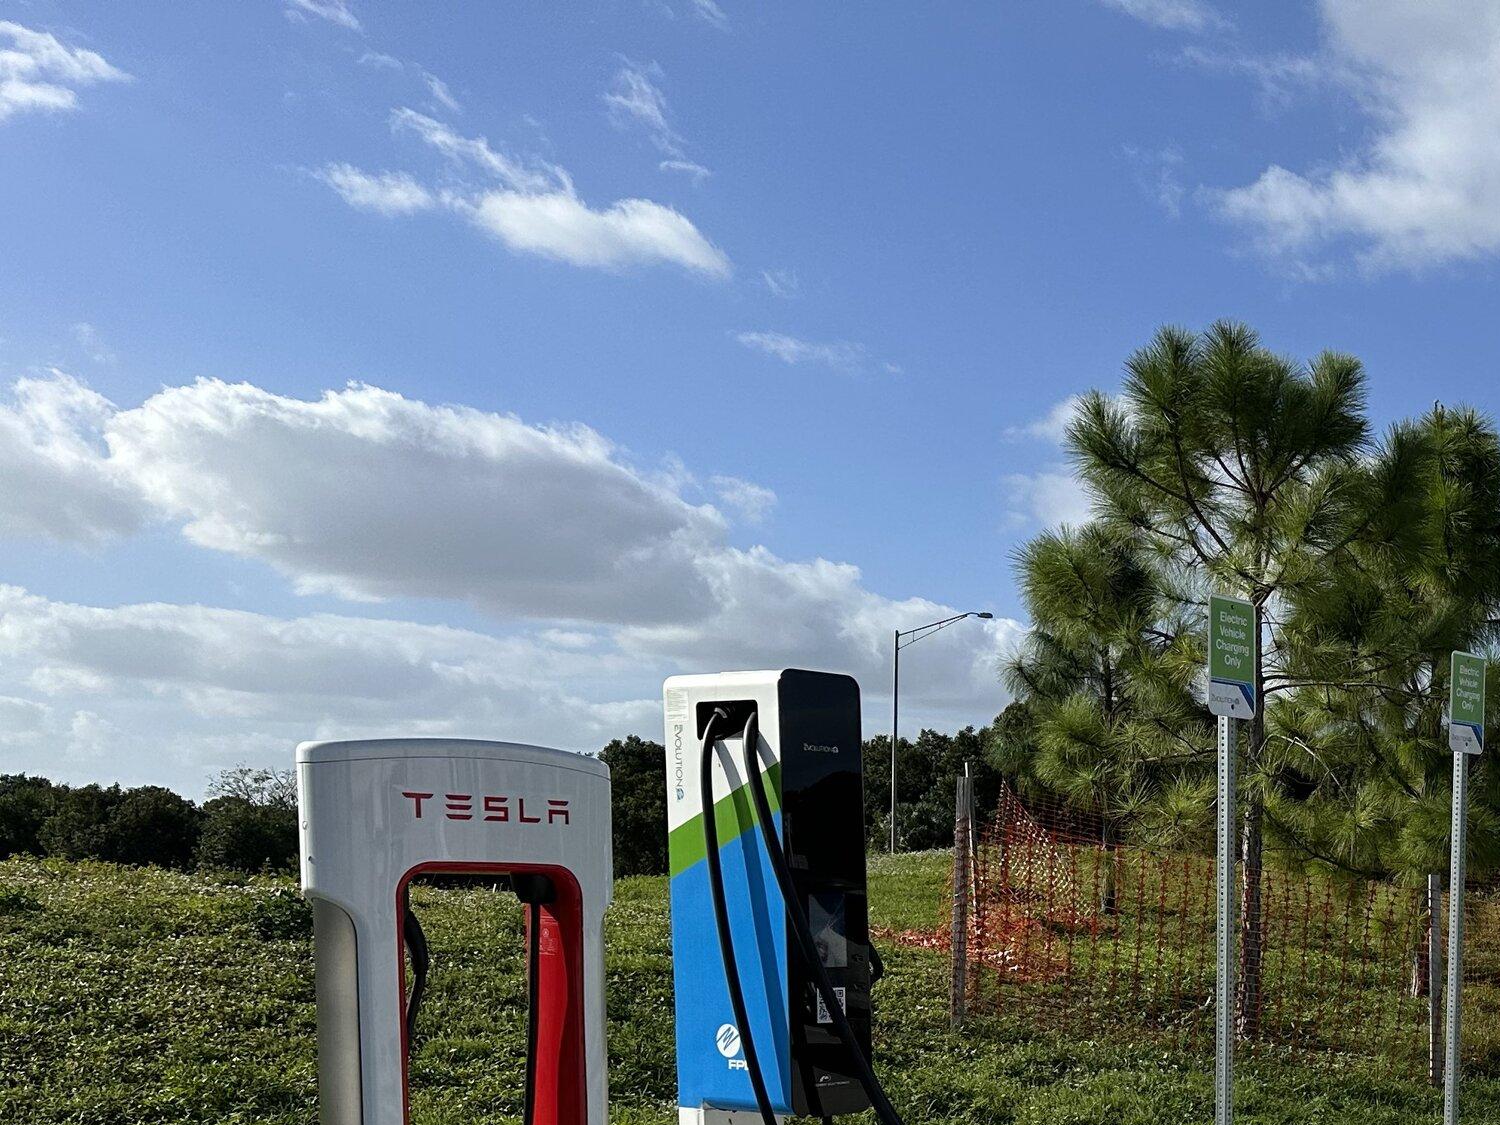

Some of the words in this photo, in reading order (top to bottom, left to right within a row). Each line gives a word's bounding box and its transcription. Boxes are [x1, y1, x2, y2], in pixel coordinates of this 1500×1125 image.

[1220, 611, 1248, 627] Electric
[1219, 624, 1246, 640] Vehicle
[1216, 638, 1250, 657] Charging
[1225, 654, 1242, 669] Only
[401, 791, 571, 826] TESLA
